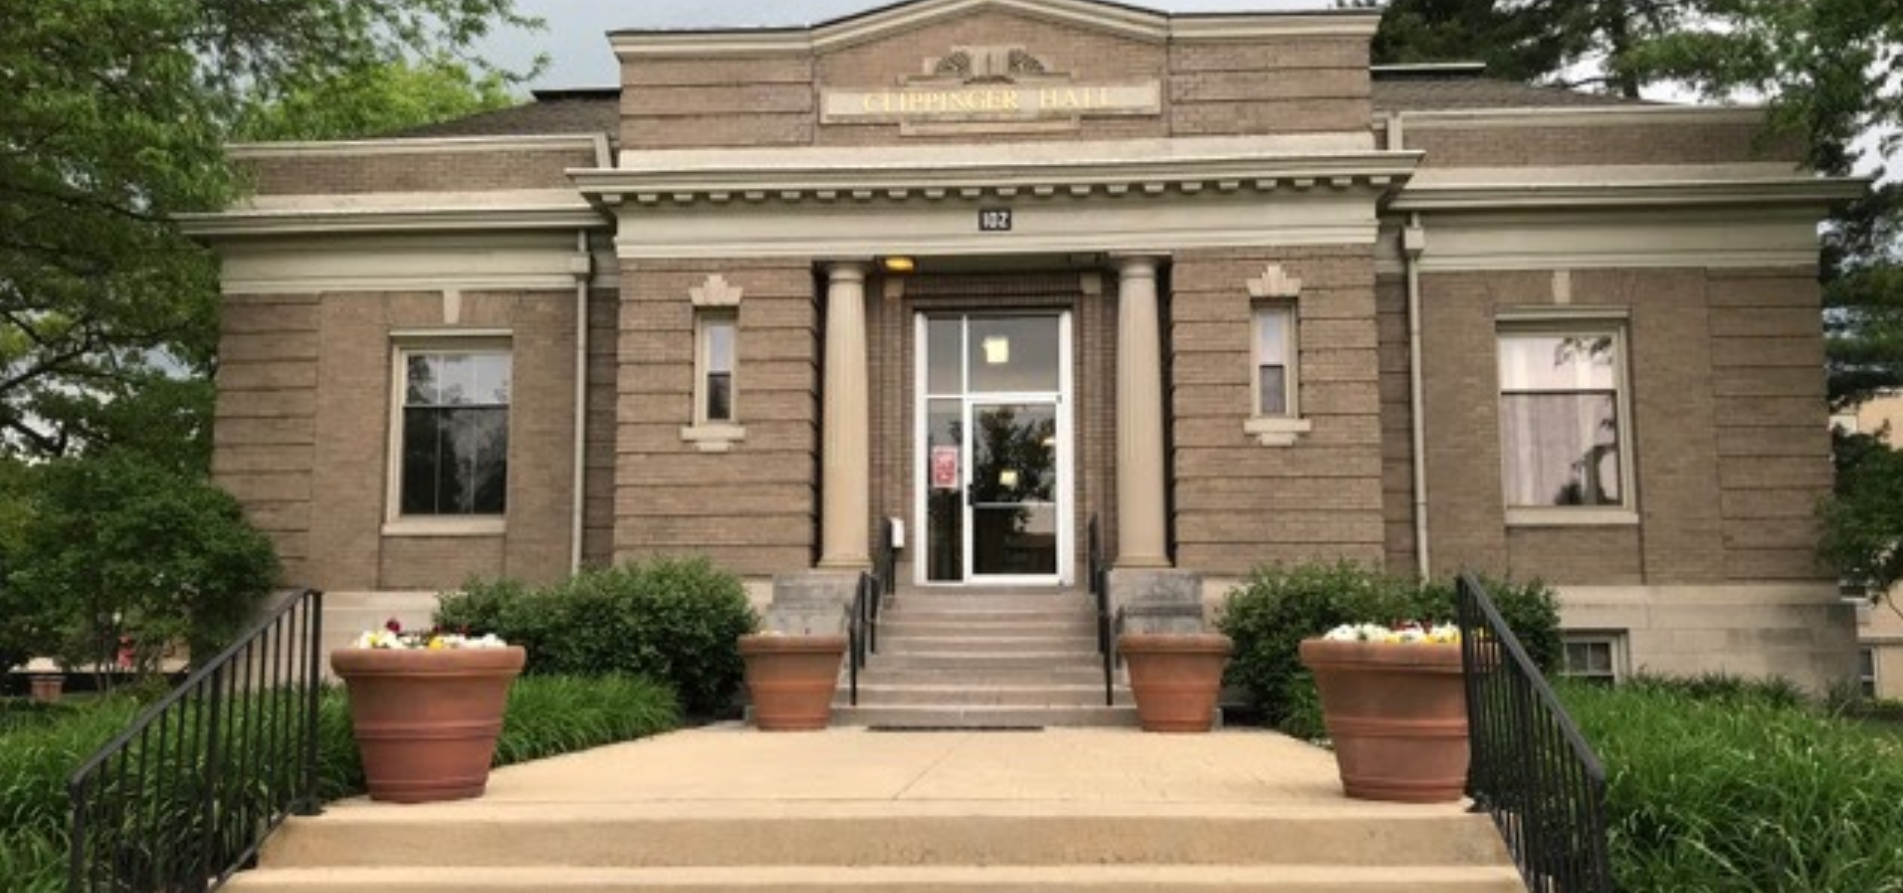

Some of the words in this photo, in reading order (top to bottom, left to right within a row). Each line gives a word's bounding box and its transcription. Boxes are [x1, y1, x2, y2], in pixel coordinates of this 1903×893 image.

[863, 90, 1018, 112] CLIPPINGER
[1040, 87, 1112, 109] HALL
[983, 212, 1009, 228] 102
